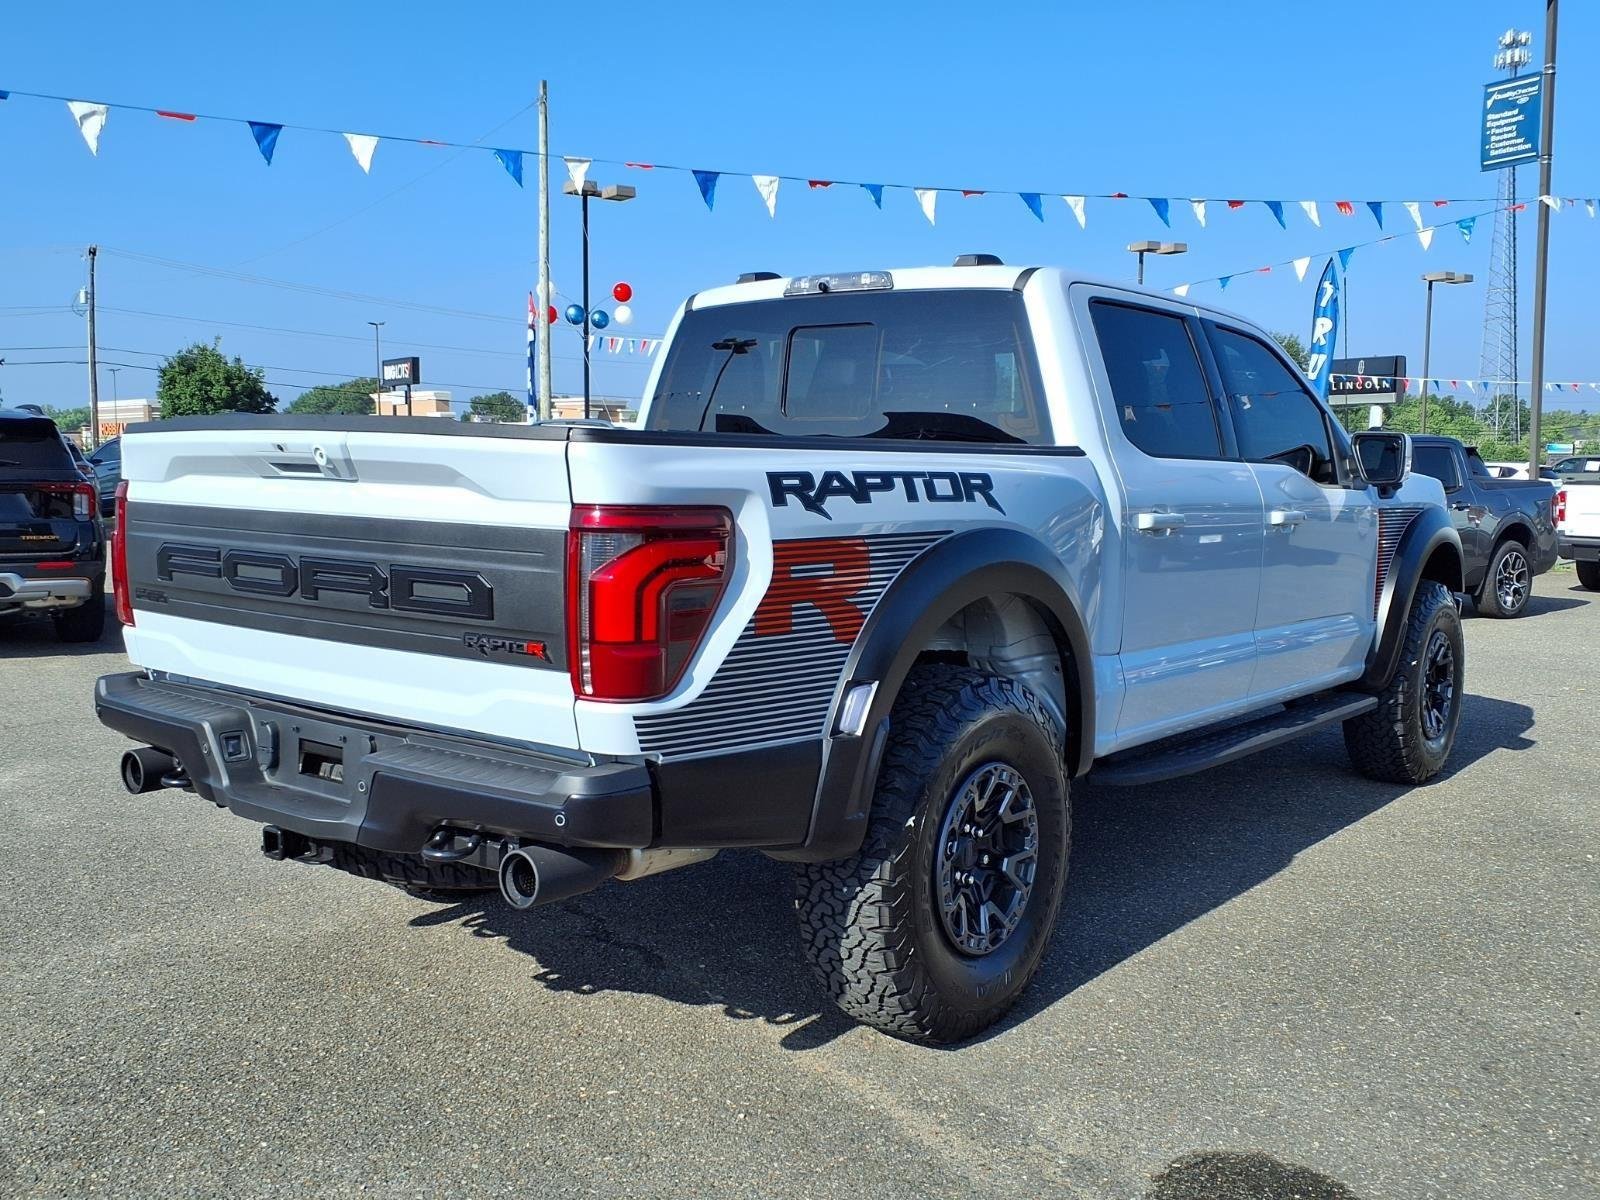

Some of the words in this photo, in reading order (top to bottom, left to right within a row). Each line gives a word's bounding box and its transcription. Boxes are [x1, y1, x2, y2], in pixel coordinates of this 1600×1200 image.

[1490, 138, 1525, 149] Customer
[1490, 144, 1532, 156] Satisfaction
[765, 471, 1007, 521] RAPTOR
[156, 541, 494, 621] FORD
[464, 632, 551, 662] RAPTOR
